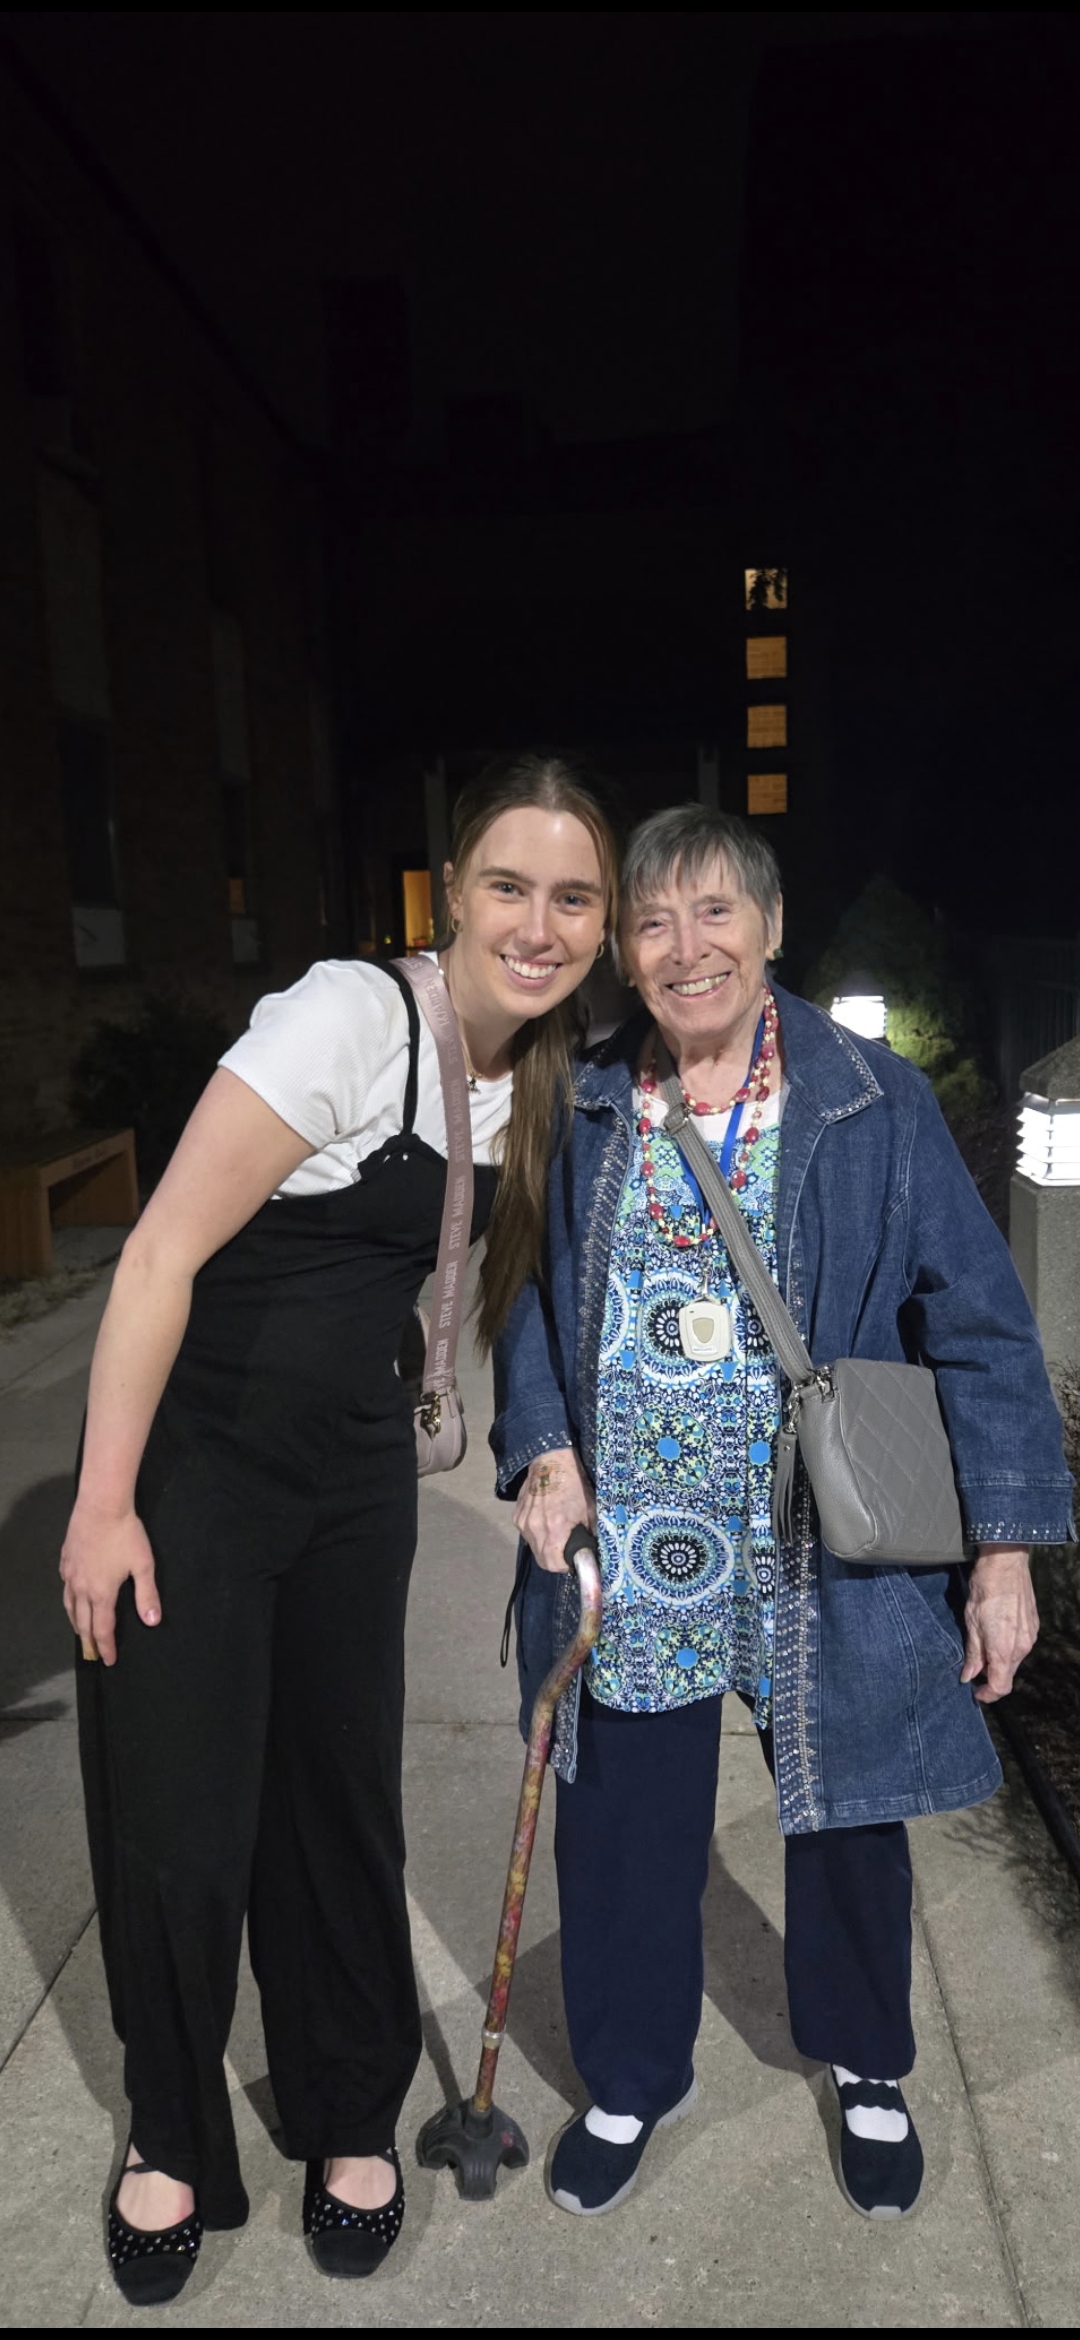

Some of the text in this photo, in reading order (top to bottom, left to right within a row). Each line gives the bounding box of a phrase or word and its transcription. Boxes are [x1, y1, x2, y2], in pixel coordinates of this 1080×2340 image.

[424, 978, 450, 1026] MADDEN
[448, 1175, 466, 1250] STEVE MADDEN
[439, 1260, 458, 1329] STEVE MADDEN
[434, 1338, 449, 1374] MADDEN
